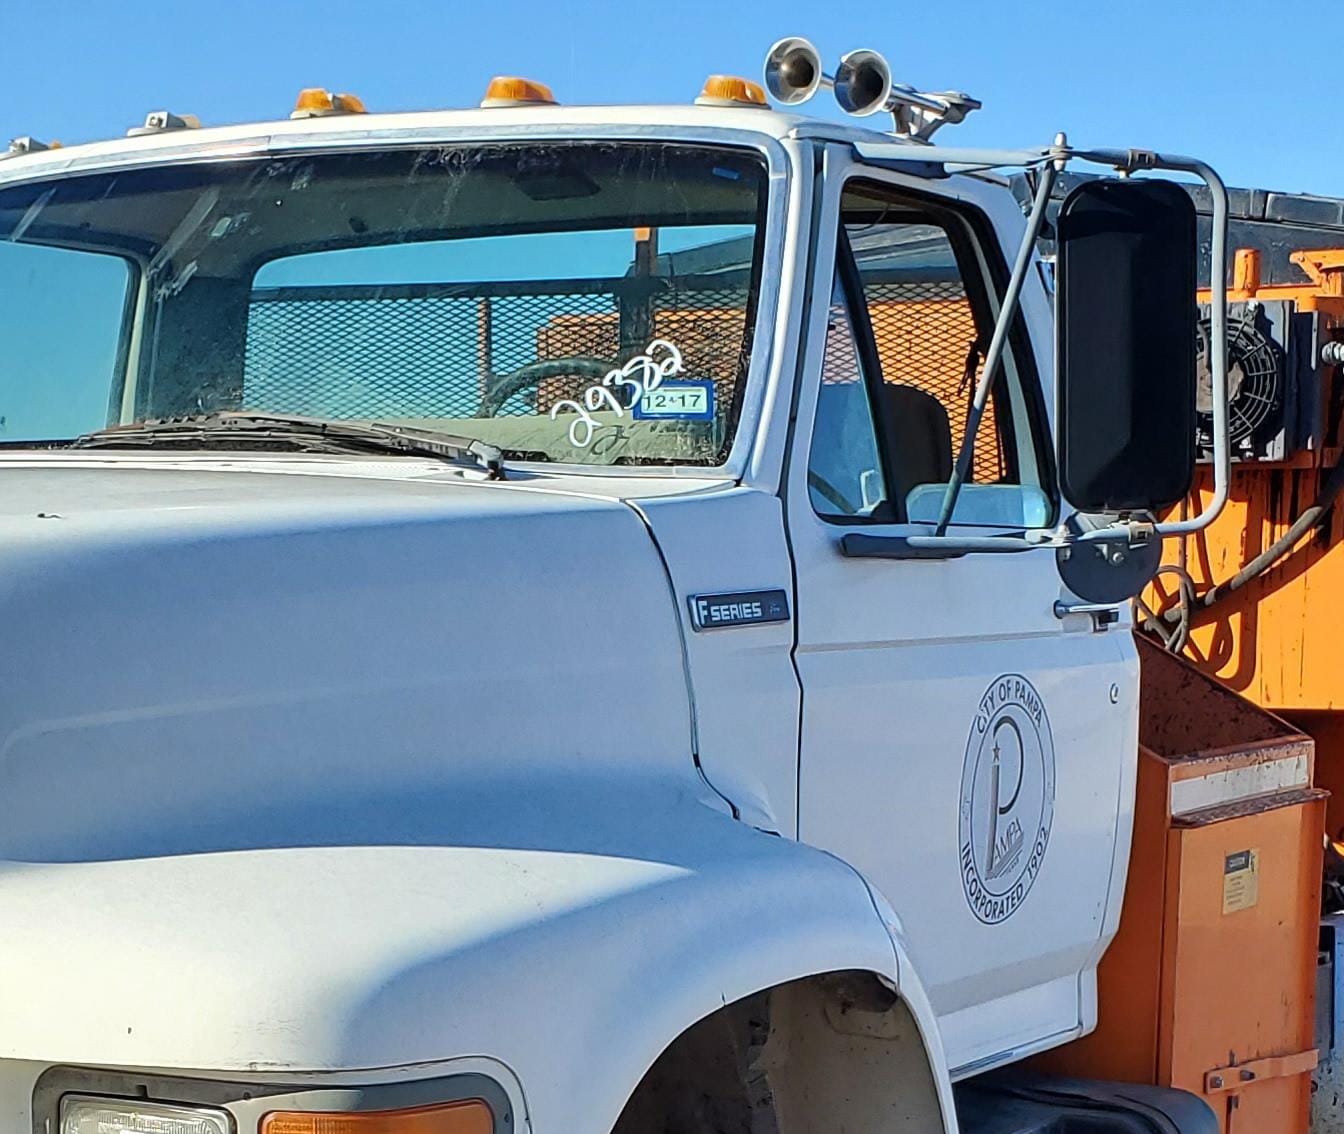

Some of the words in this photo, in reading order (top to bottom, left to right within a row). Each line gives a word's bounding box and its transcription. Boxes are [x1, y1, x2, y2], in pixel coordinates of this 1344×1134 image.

[710, 602, 762, 621] SERIES
[977, 693, 996, 734] CITY
[998, 680, 1011, 702] OF
[1015, 680, 1043, 729] PAMPA
[962, 841, 1024, 920] INCORPORATED
[1027, 825, 1049, 880] 1902
